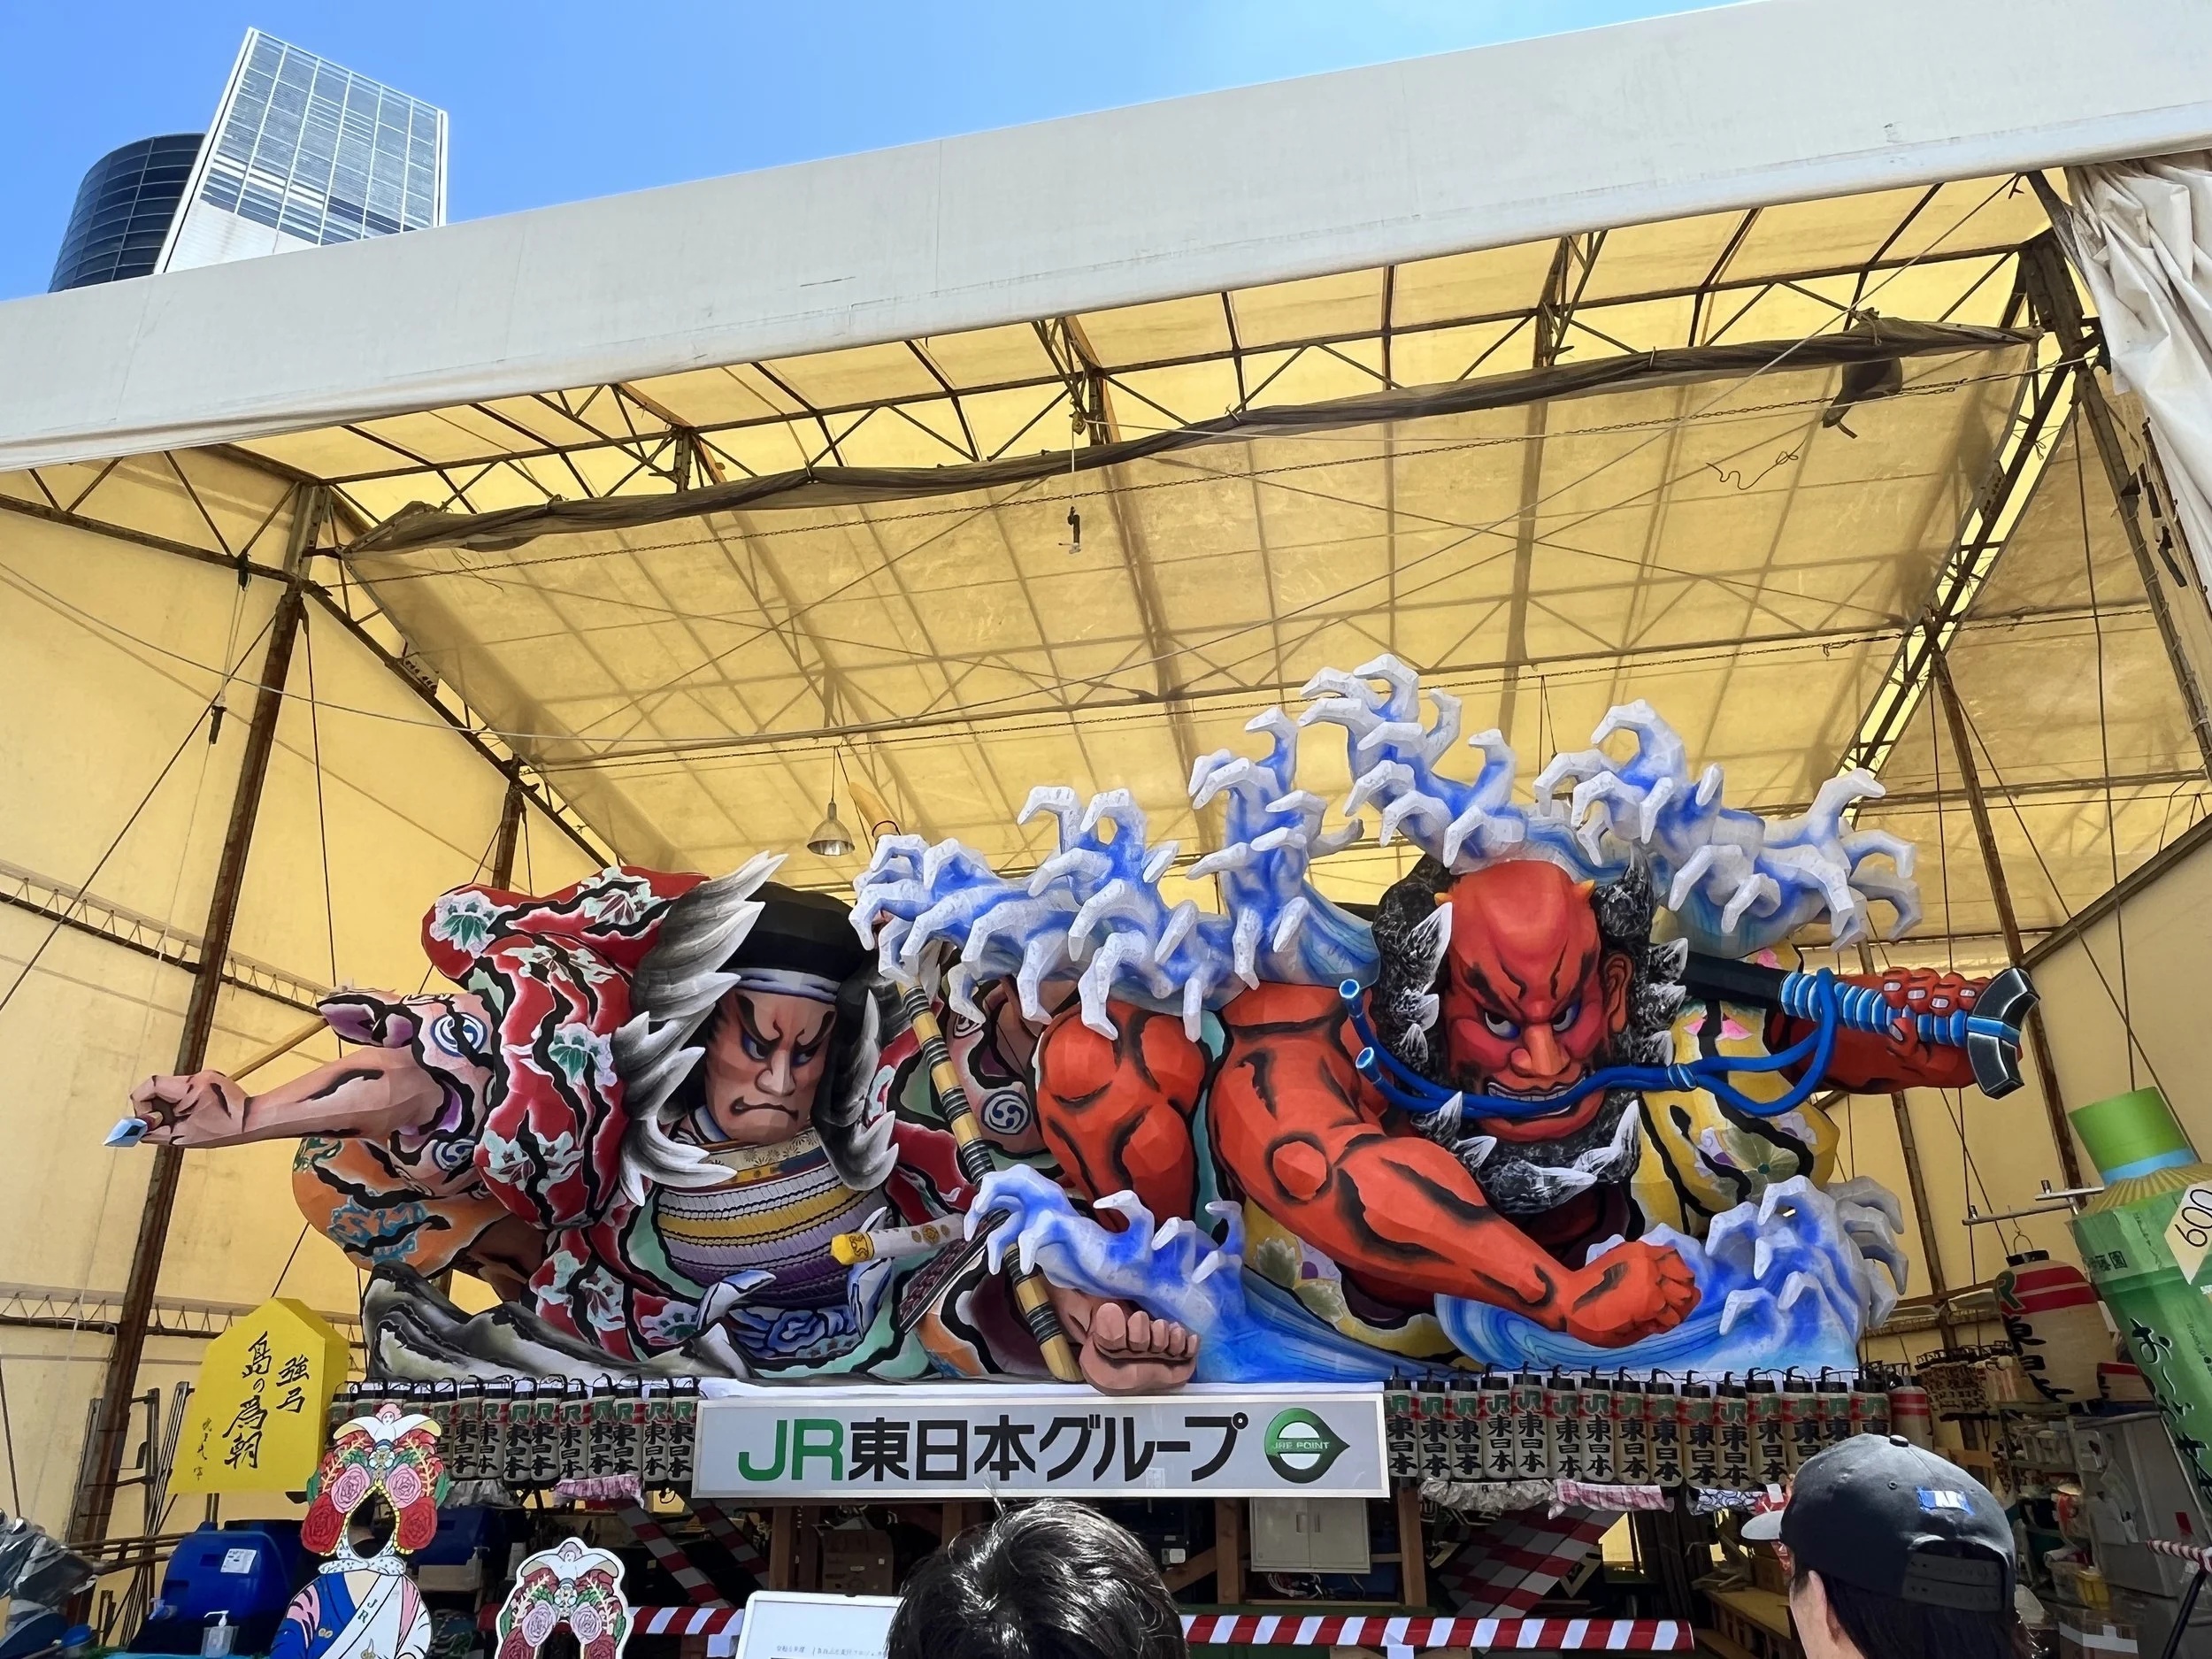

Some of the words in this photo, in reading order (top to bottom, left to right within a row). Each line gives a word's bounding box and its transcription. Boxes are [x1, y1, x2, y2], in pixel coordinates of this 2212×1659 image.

[276, 1354, 310, 1414] 強弓
[738, 1412, 1249, 1482] JR東日本グループ
[357, 1599, 378, 1624] JR
